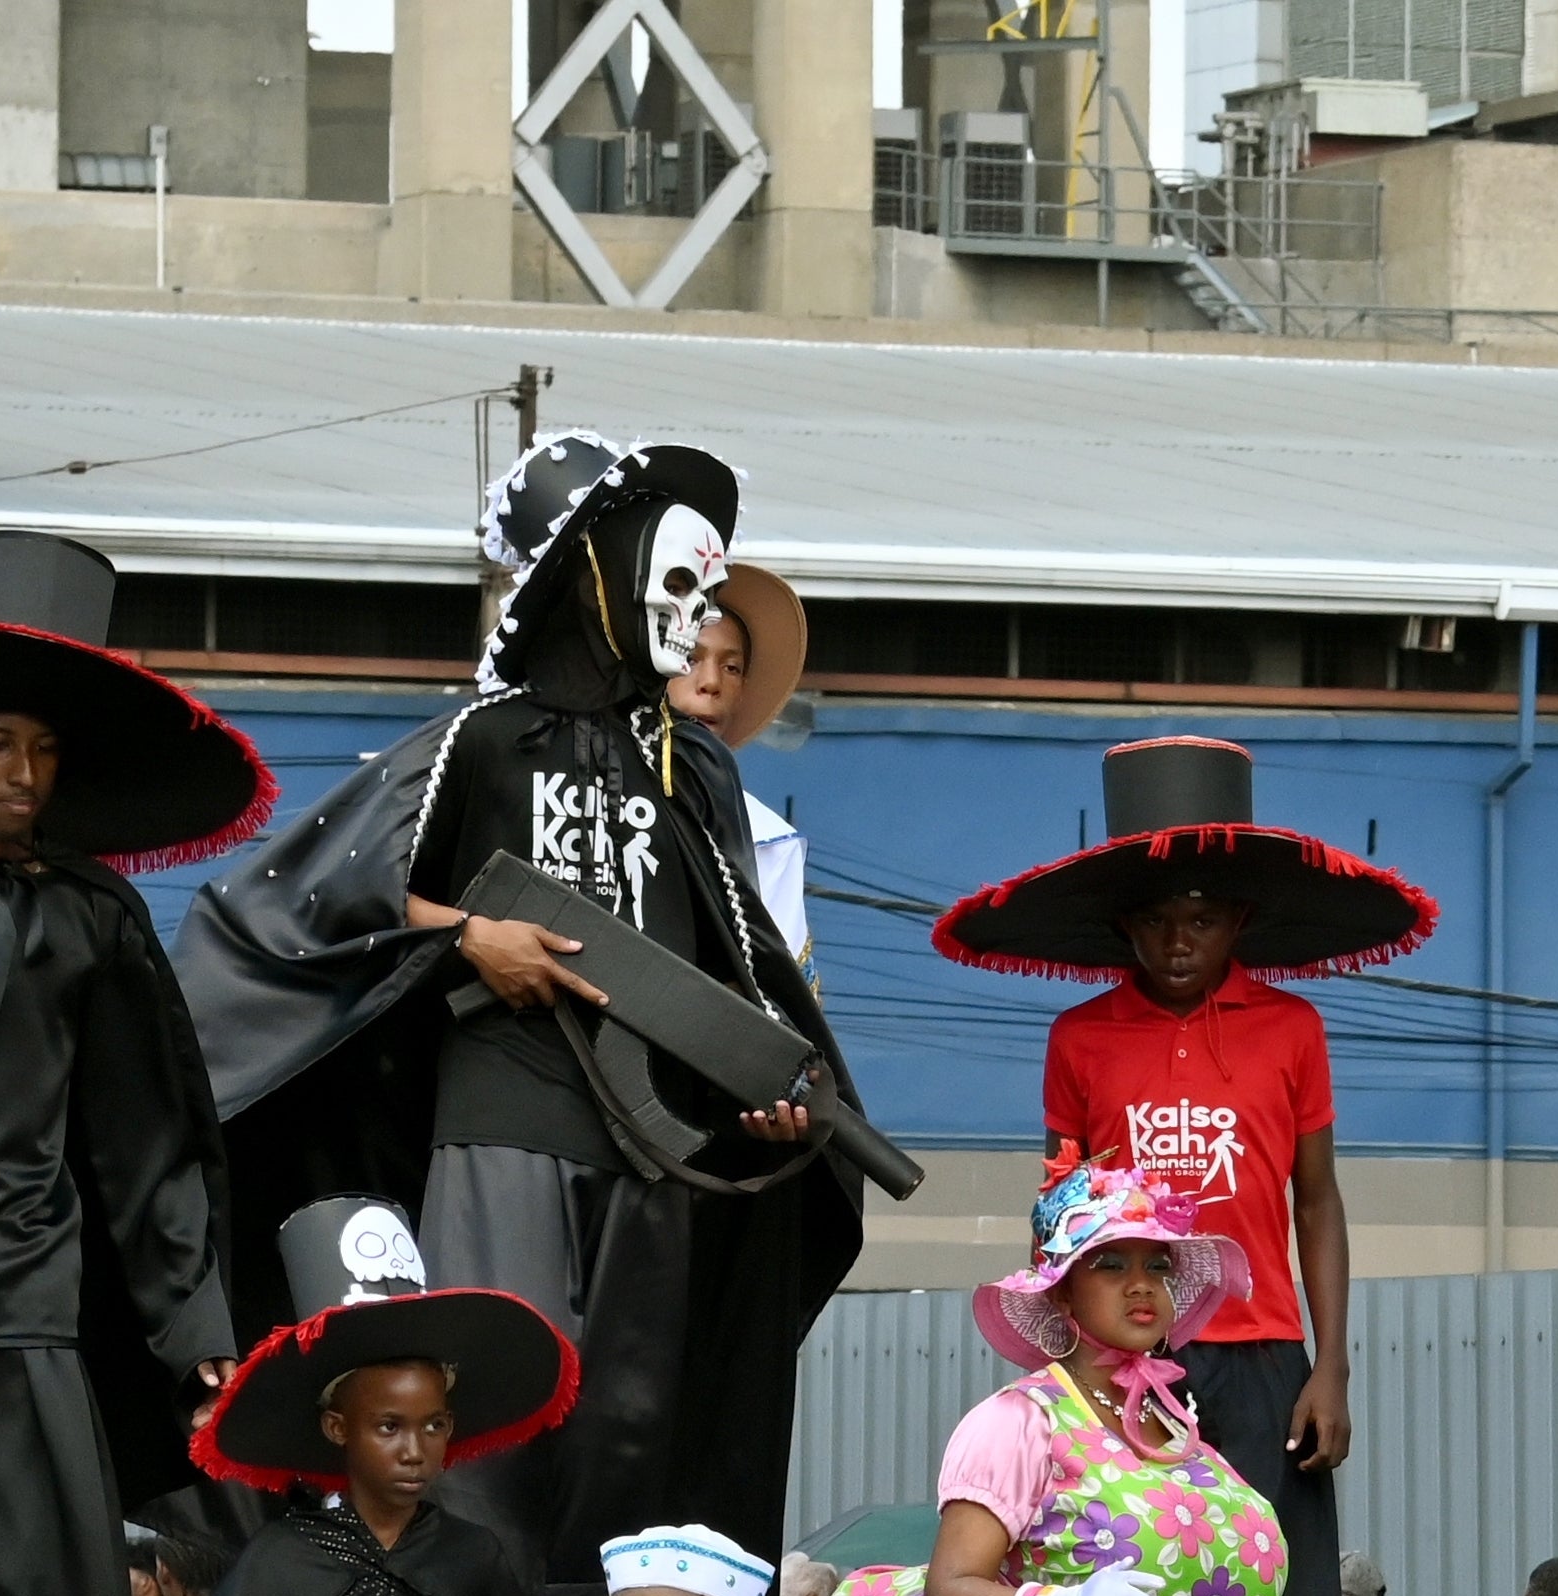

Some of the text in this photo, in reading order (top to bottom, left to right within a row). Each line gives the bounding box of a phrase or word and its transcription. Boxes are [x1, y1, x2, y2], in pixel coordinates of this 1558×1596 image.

[1125, 1098, 1237, 1131] Kaiso
[1130, 1127, 1207, 1159] Kah
[1133, 1155, 1208, 1170] Valencia
